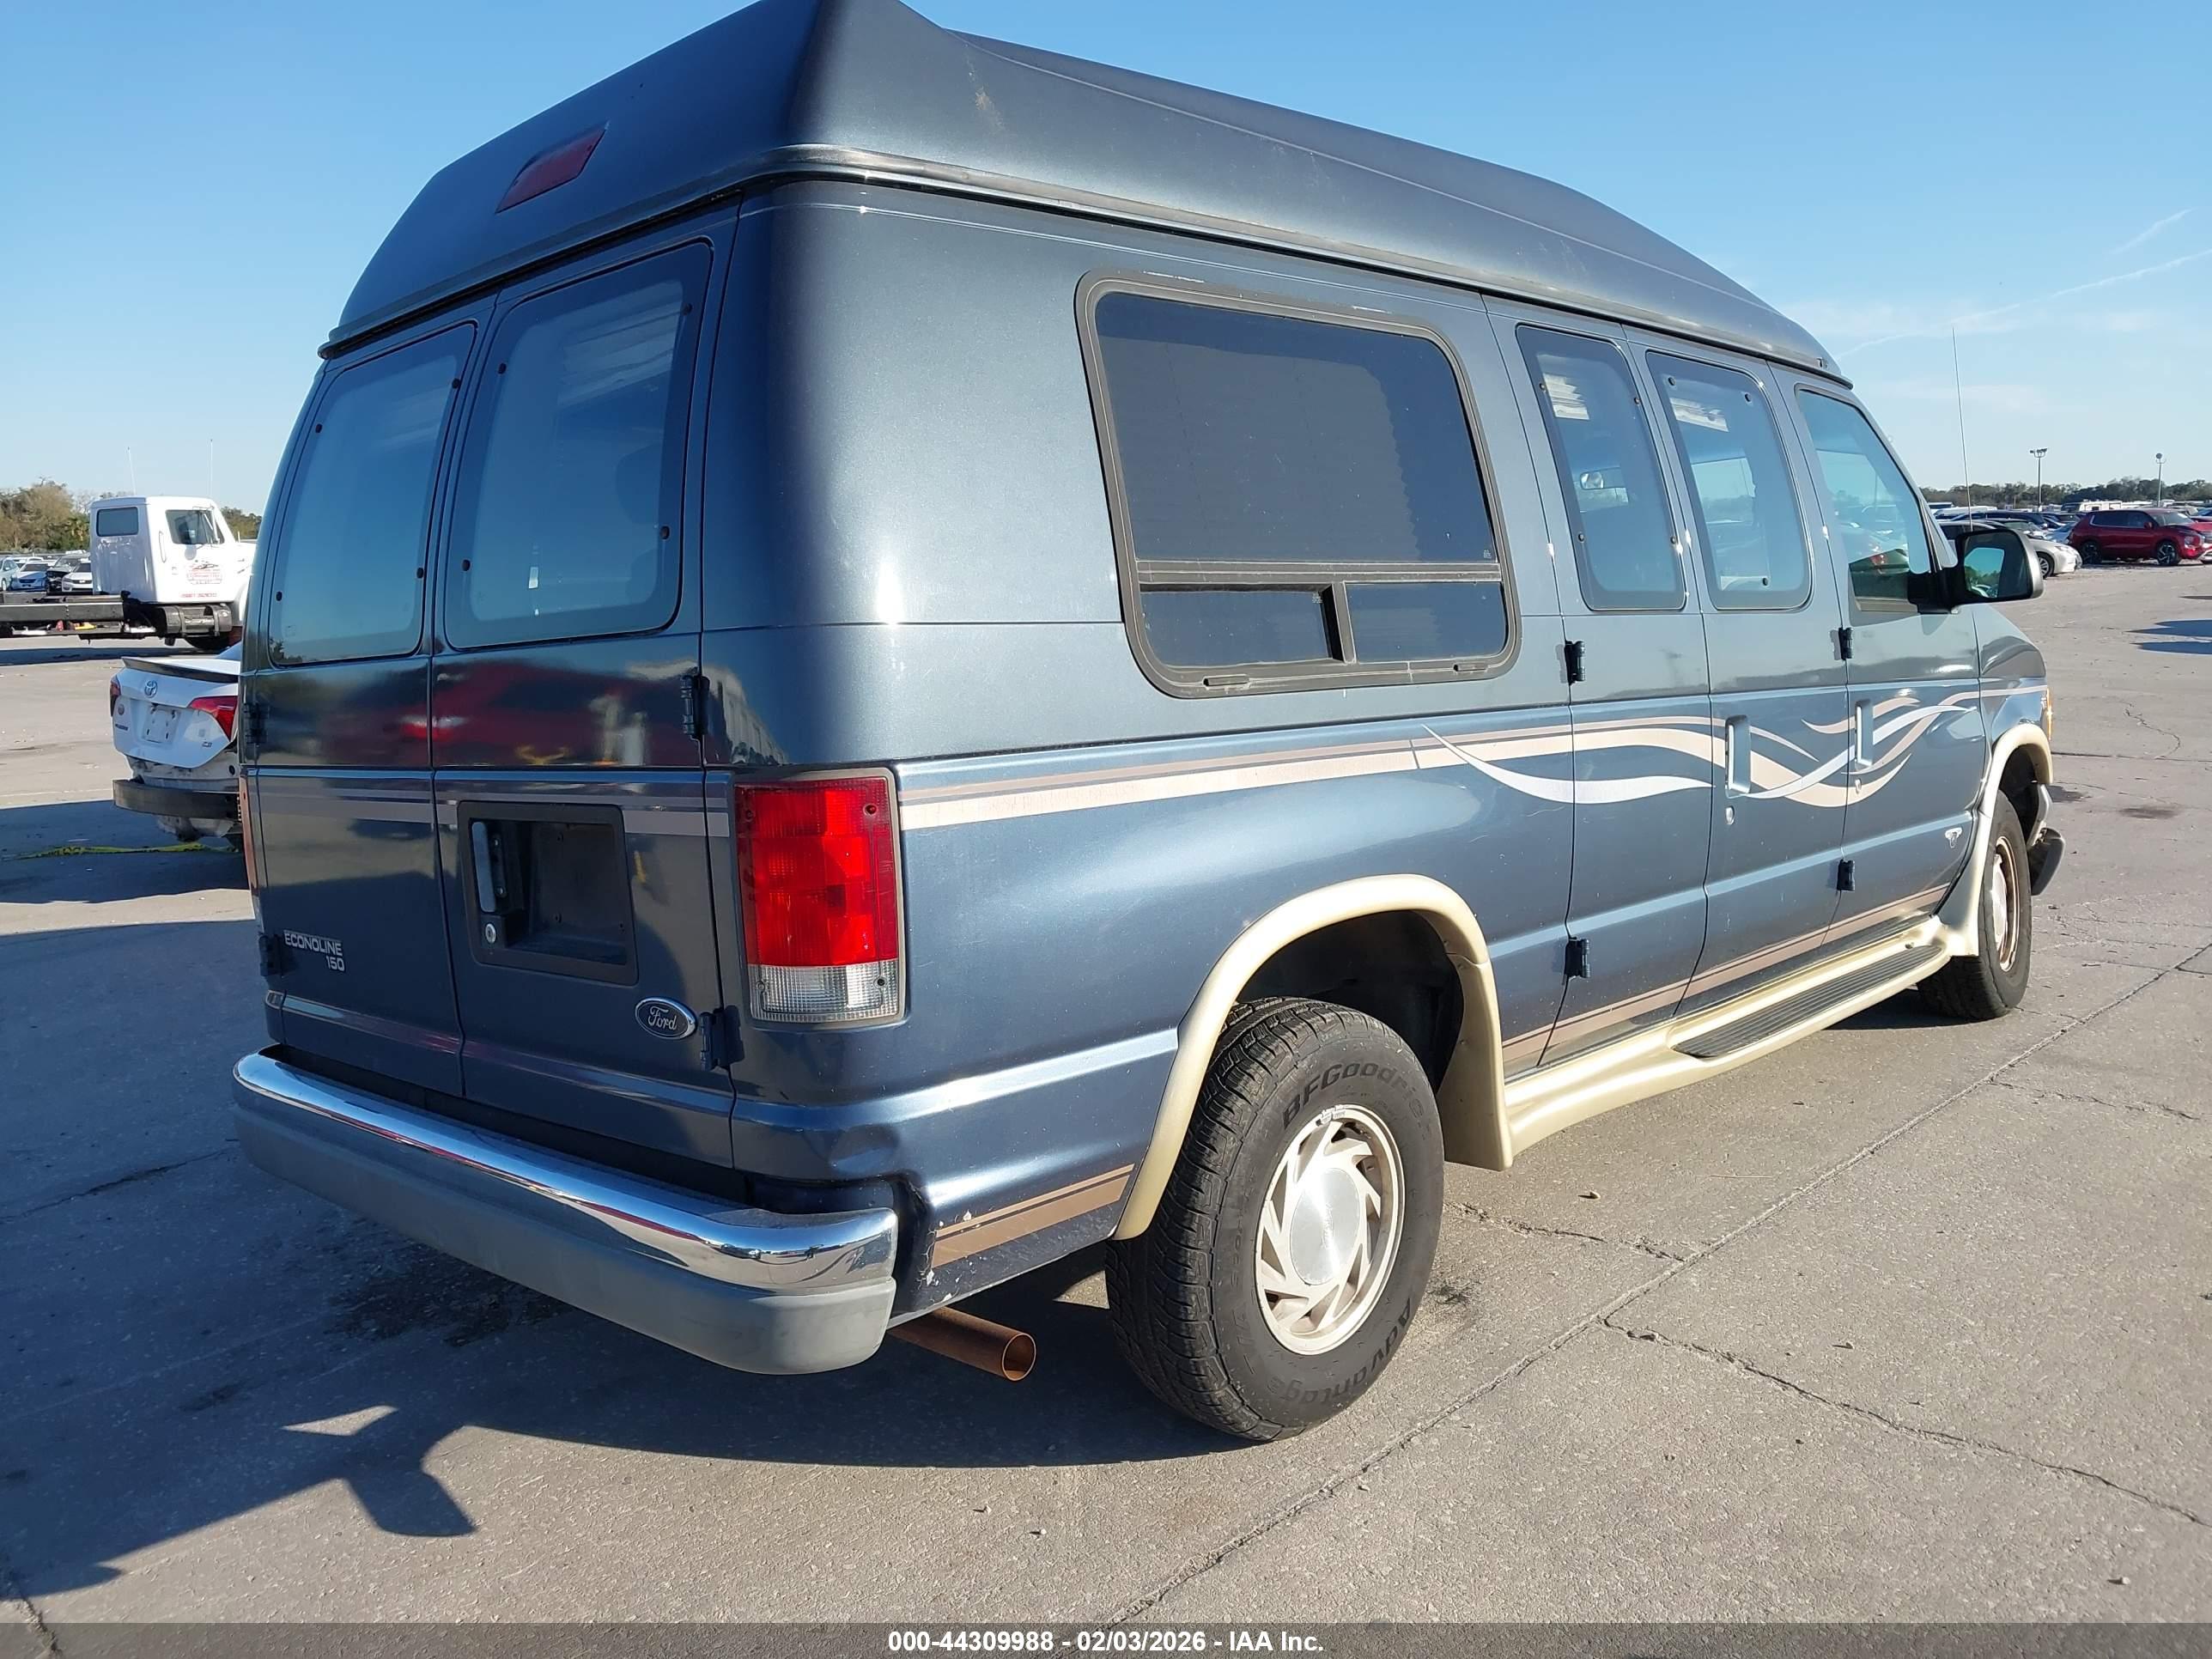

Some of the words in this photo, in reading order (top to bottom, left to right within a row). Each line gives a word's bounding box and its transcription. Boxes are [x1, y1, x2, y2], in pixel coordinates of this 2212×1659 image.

[284, 933, 343, 957] ECONOLINE
[326, 955, 345, 972] 150
[648, 1006, 678, 1030] Ford
